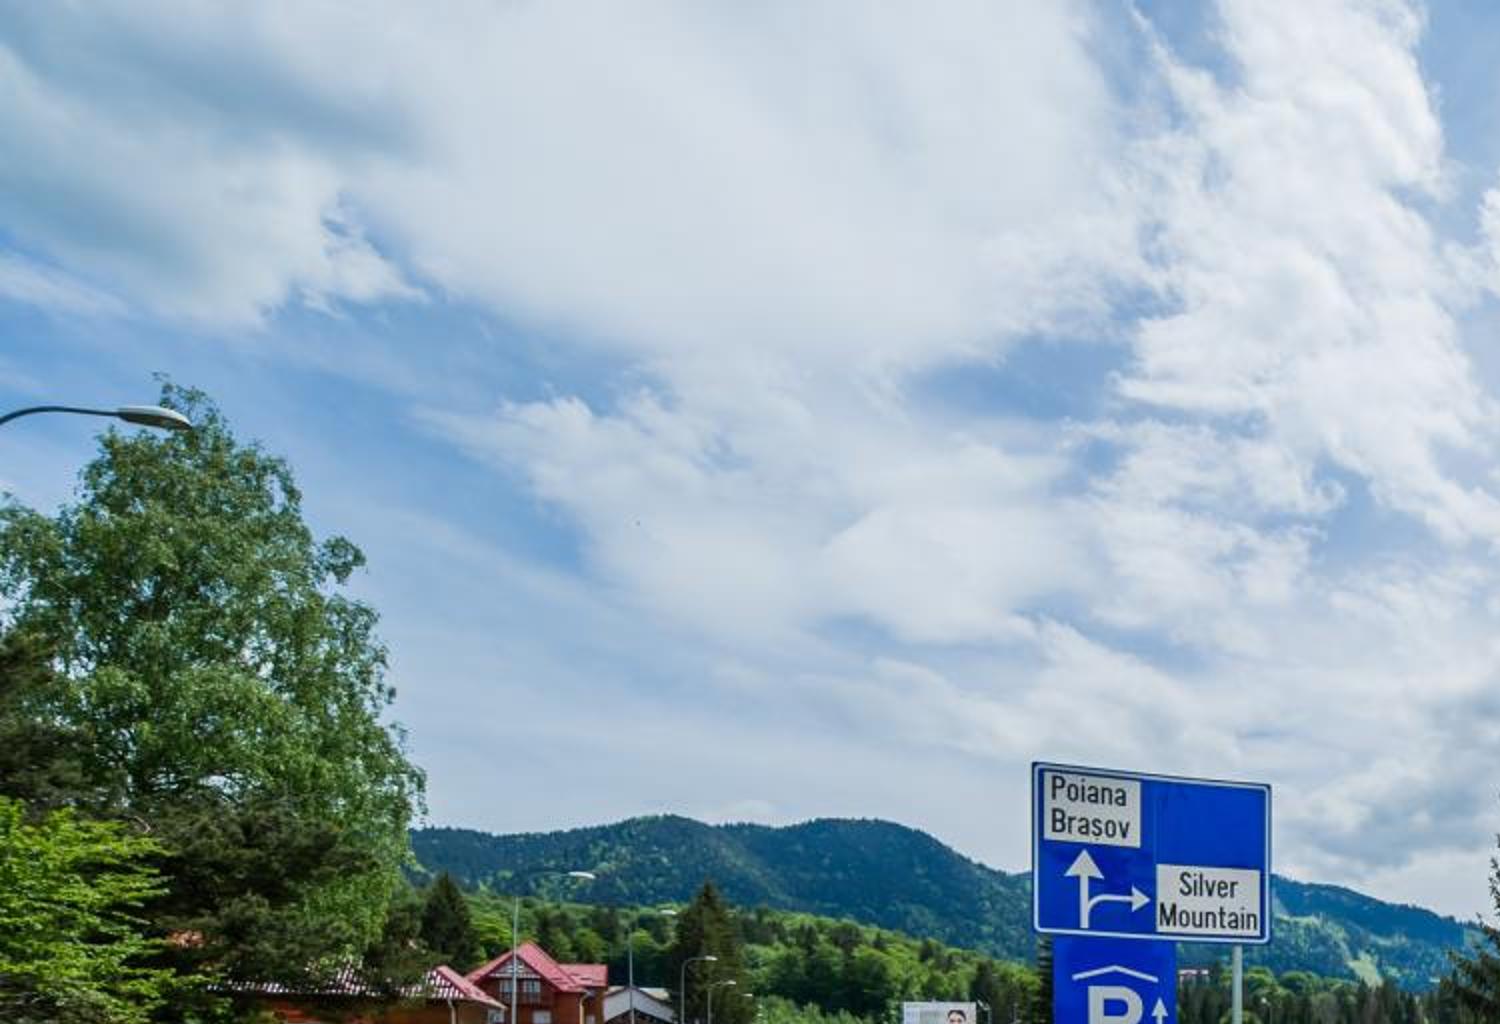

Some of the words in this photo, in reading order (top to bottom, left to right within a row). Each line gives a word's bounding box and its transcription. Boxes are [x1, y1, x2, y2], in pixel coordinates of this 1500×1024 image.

[1051, 775, 1127, 807] Poiana
[1179, 871, 1239, 898] Silver
[1159, 902, 1258, 931] Mountain
